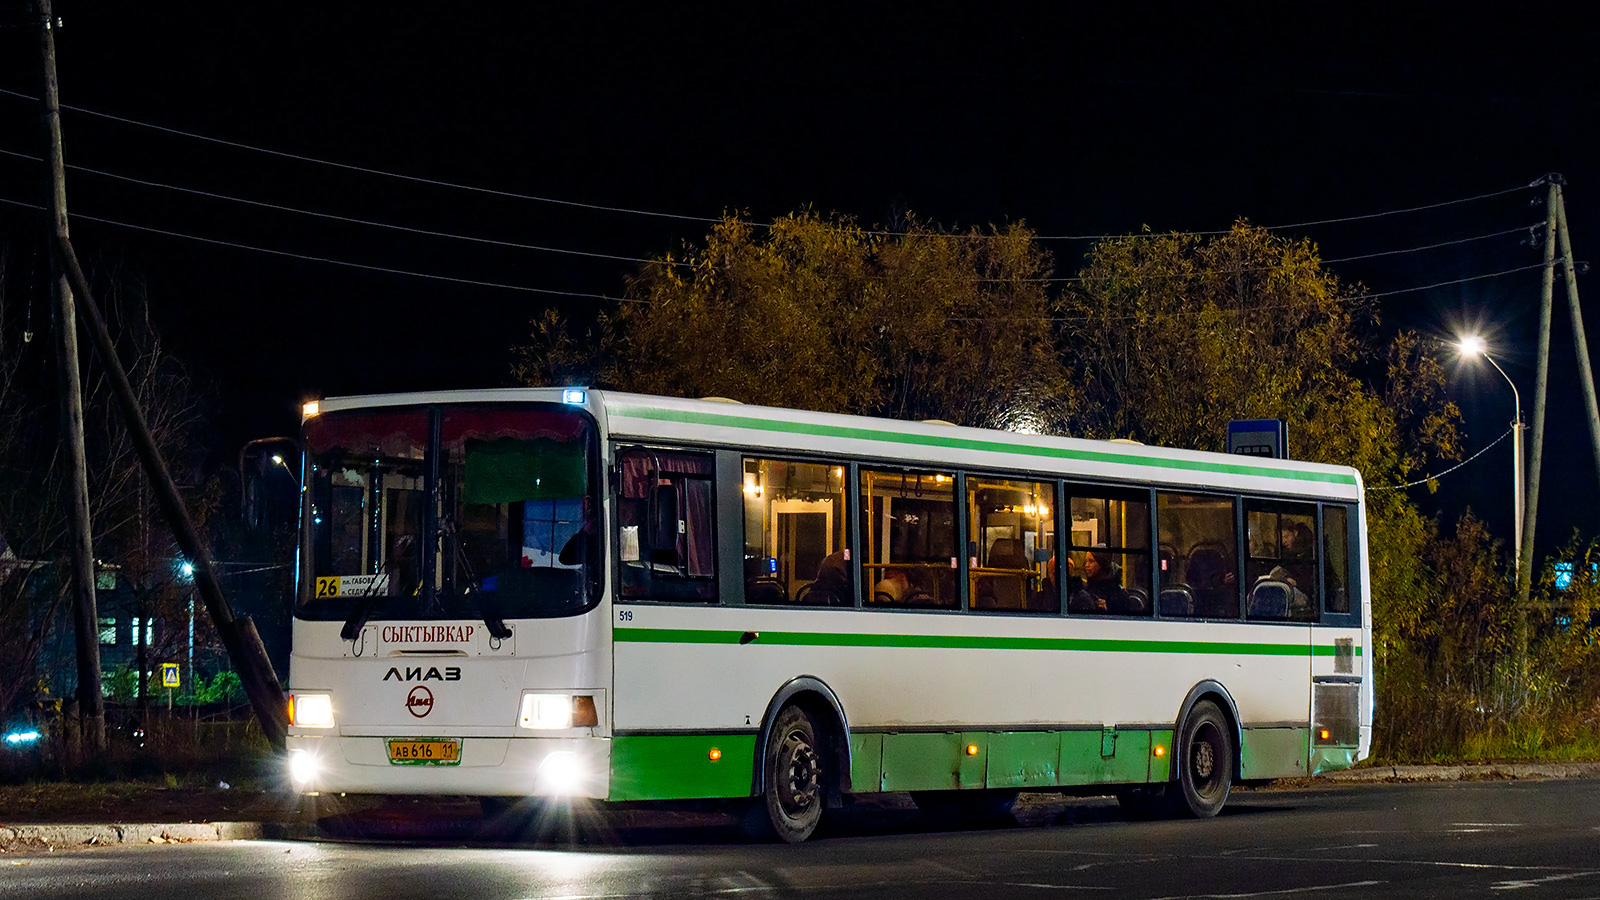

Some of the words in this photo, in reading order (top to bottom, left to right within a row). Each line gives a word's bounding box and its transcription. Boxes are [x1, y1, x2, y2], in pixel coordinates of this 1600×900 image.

[319, 579, 337, 596] 26
[351, 577, 375, 585] ГАБОВ
[619, 610, 633, 621] 519
[382, 625, 474, 643] СЫКТЫВКАР
[382, 667, 462, 682] ЛИАЗ
[442, 743, 453, 754] 11
